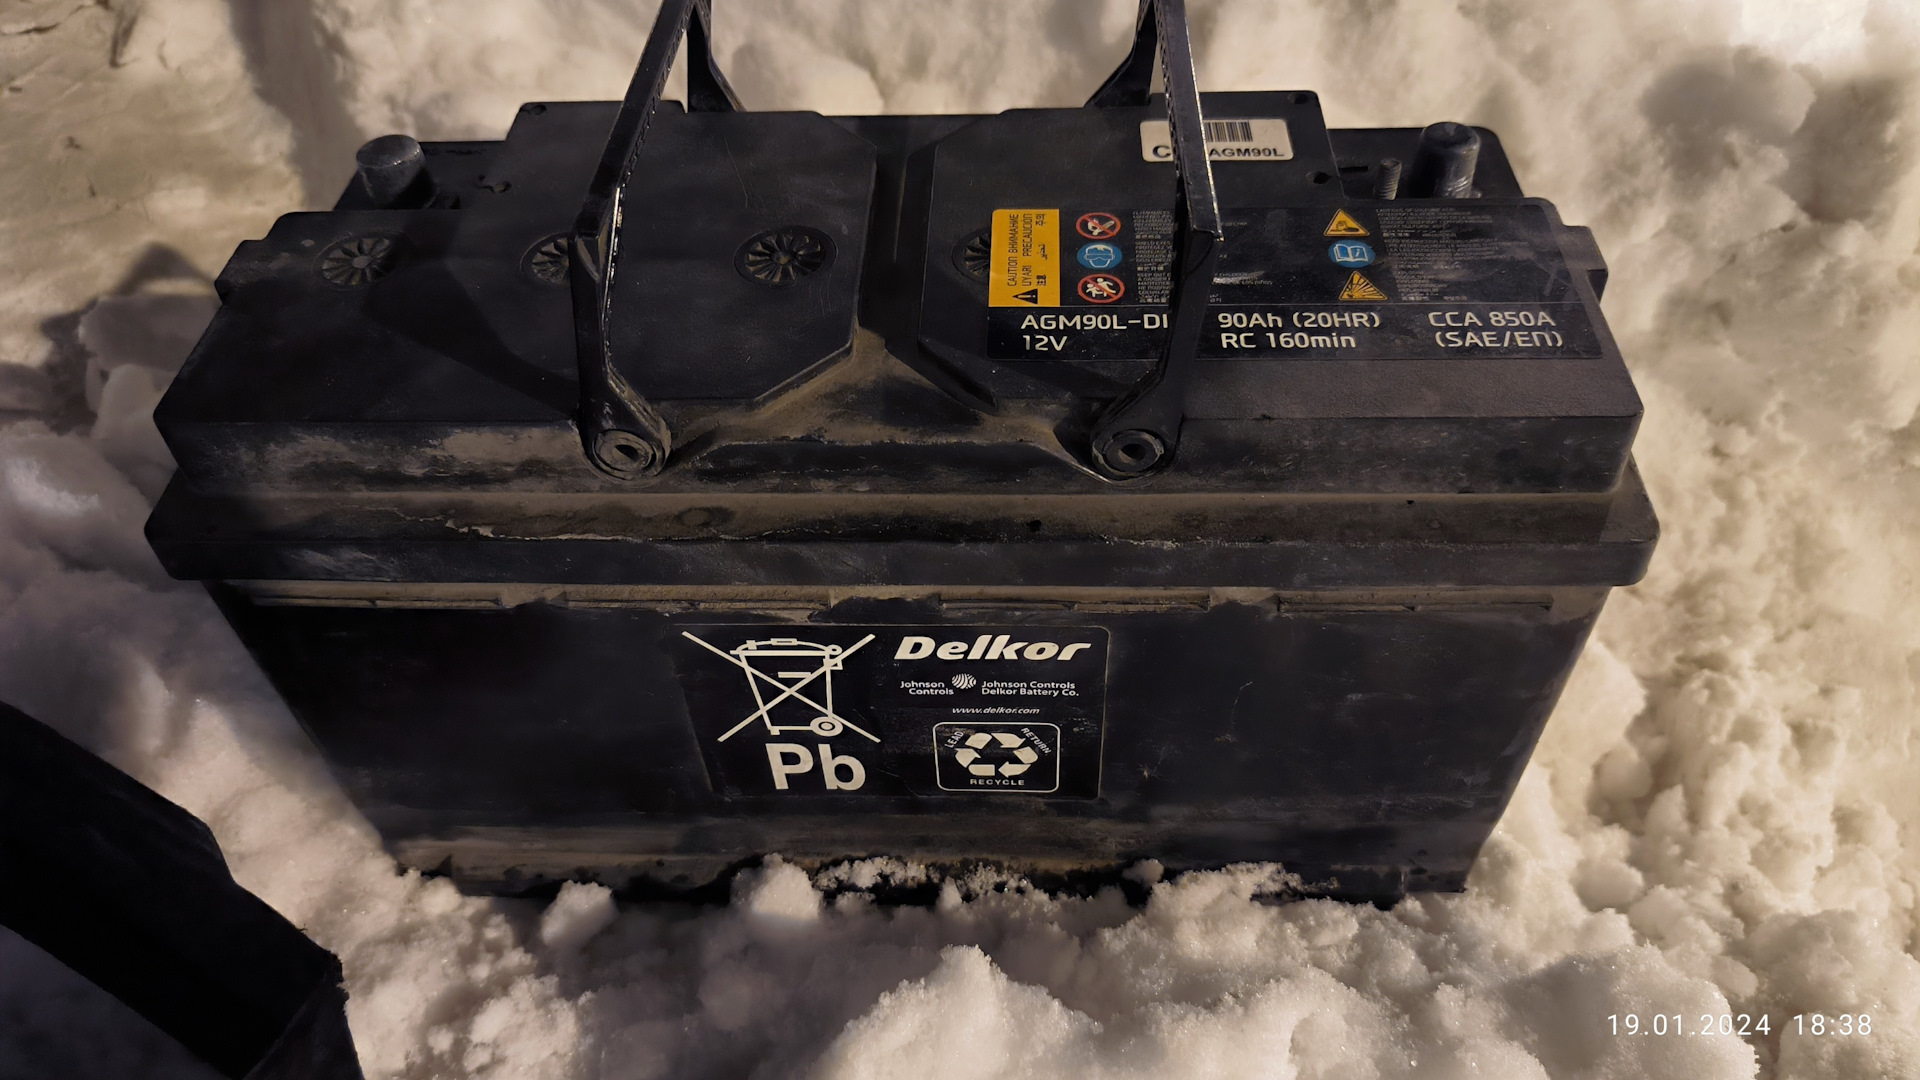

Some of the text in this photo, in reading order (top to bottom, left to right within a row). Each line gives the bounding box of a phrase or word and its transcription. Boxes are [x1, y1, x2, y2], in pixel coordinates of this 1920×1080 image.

[1209, 148, 1284, 157] AGM90L
[1218, 312, 1381, 329] 90Ah (20HR)
[1428, 312, 1557, 327] CCA 850A
[1023, 335, 1068, 351] 12V
[1221, 333, 1356, 348] RC 160min
[894, 634, 1092, 661] Delkor
[900, 680, 945, 689] Johnson
[909, 687, 954, 695] Controls
[981, 680, 1076, 689] Johnson Controls
[981, 687, 1080, 697] Delkor Battery Co.
[952, 706, 1041, 715] www.delkor.com
[944, 731, 964, 748] LEAD
[1020, 727, 1052, 754] RETURN
[765, 742, 867, 791] Pb
[969, 778, 1025, 786] RECYCLE
